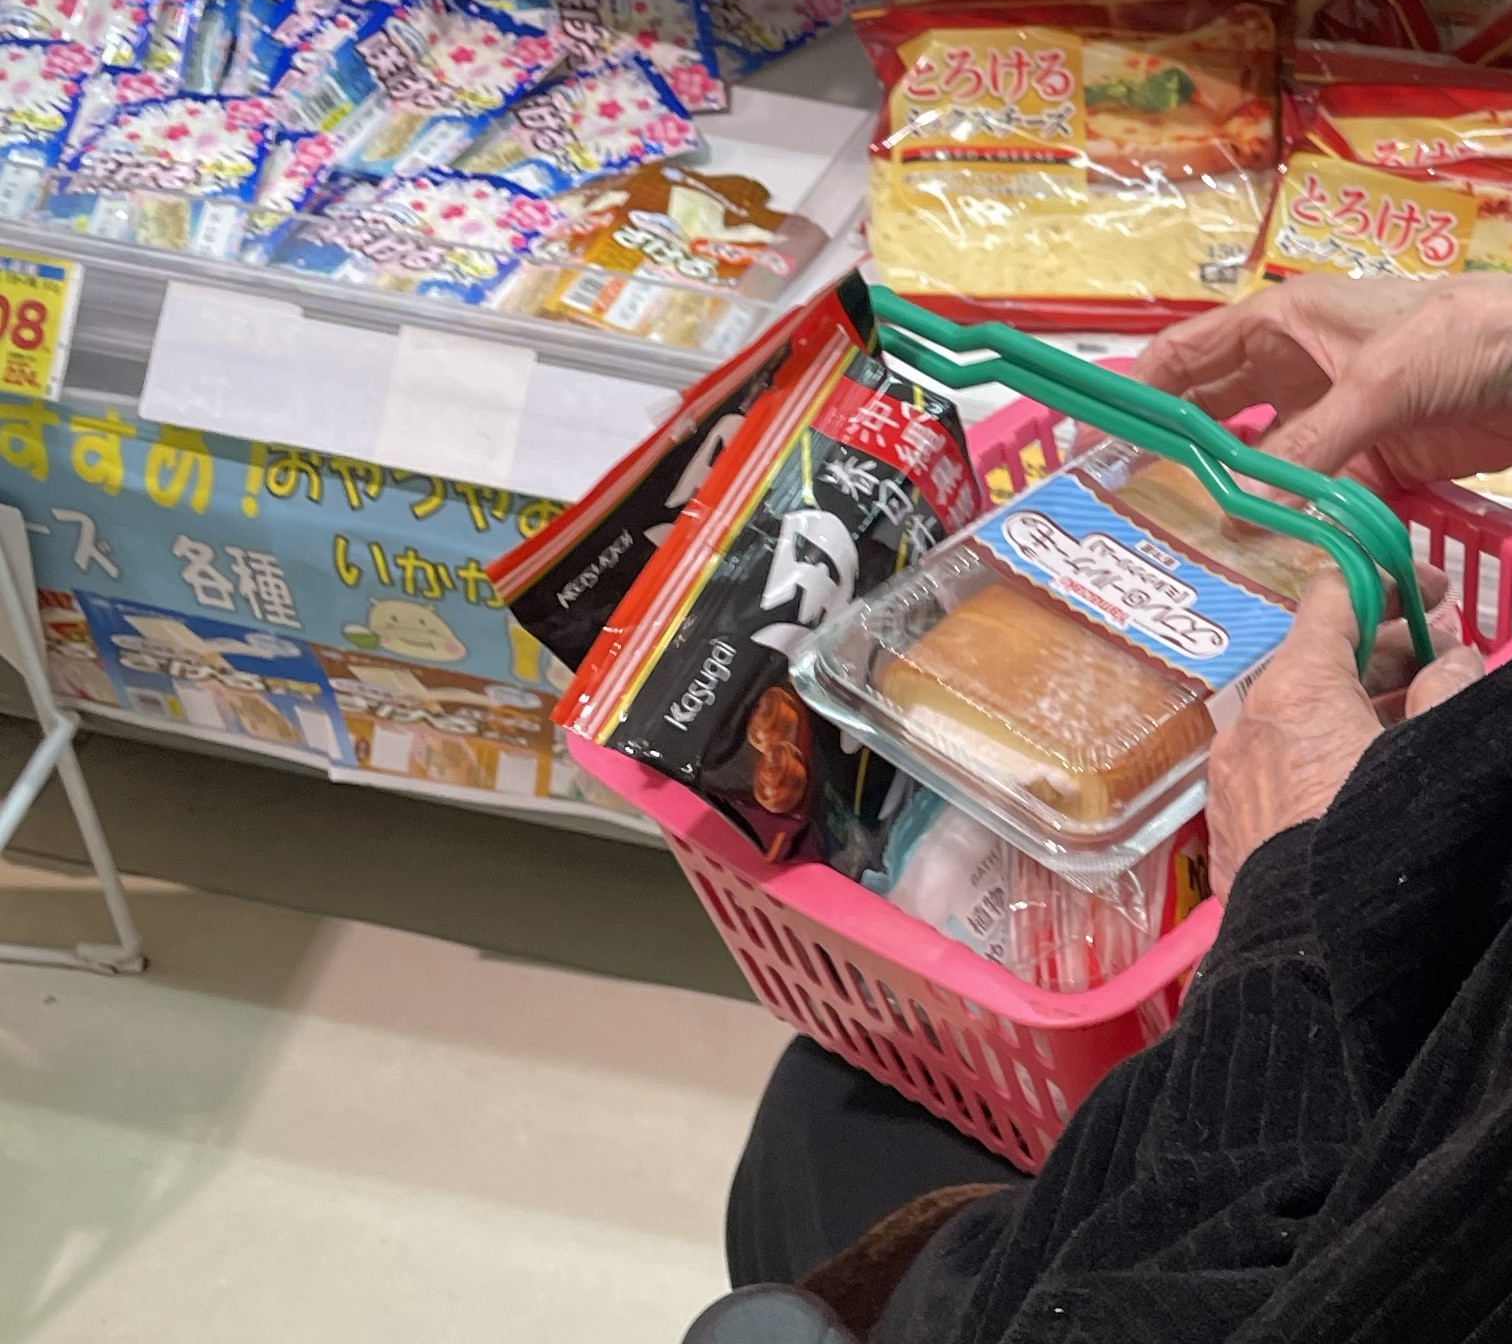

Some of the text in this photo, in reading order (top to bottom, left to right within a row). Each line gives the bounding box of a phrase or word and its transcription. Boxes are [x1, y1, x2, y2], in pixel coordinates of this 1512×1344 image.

[903, 44, 1074, 102] とろける
[1291, 174, 1458, 265] とろける
[172, 533, 303, 630] 各種
[663, 637, 738, 732] Kasugai
